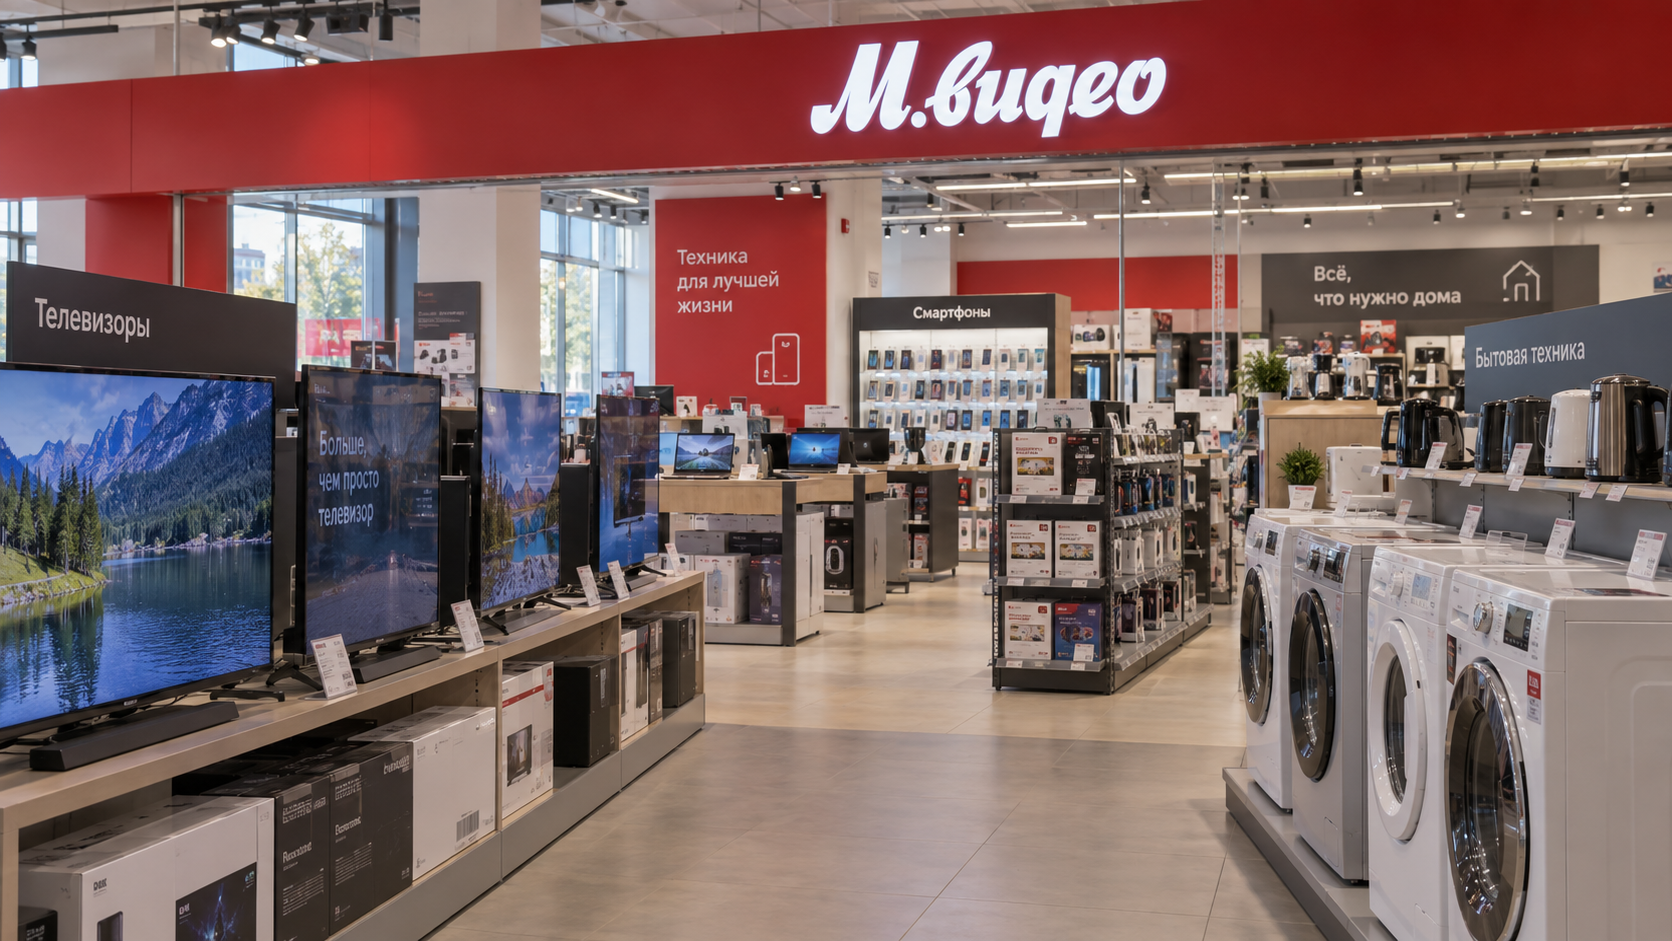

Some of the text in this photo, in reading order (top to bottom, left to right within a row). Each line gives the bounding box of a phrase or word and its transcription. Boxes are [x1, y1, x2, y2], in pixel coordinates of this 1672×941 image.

[810, 40, 1167, 138] М.видео
[677, 249, 748, 265] Техника
[677, 270, 779, 292] для лучшей
[1314, 265, 1351, 283] Всё,
[677, 299, 733, 313] жизни
[1314, 290, 1461, 309] что нужно дома
[35, 297, 150, 343] Телевизоры
[913, 305, 991, 321] Смартфоны
[1475, 341, 1585, 368] Бытовая техника
[319, 430, 367, 458] Больше,
[318, 470, 380, 496] чем просто
[318, 503, 374, 527] телевизор
